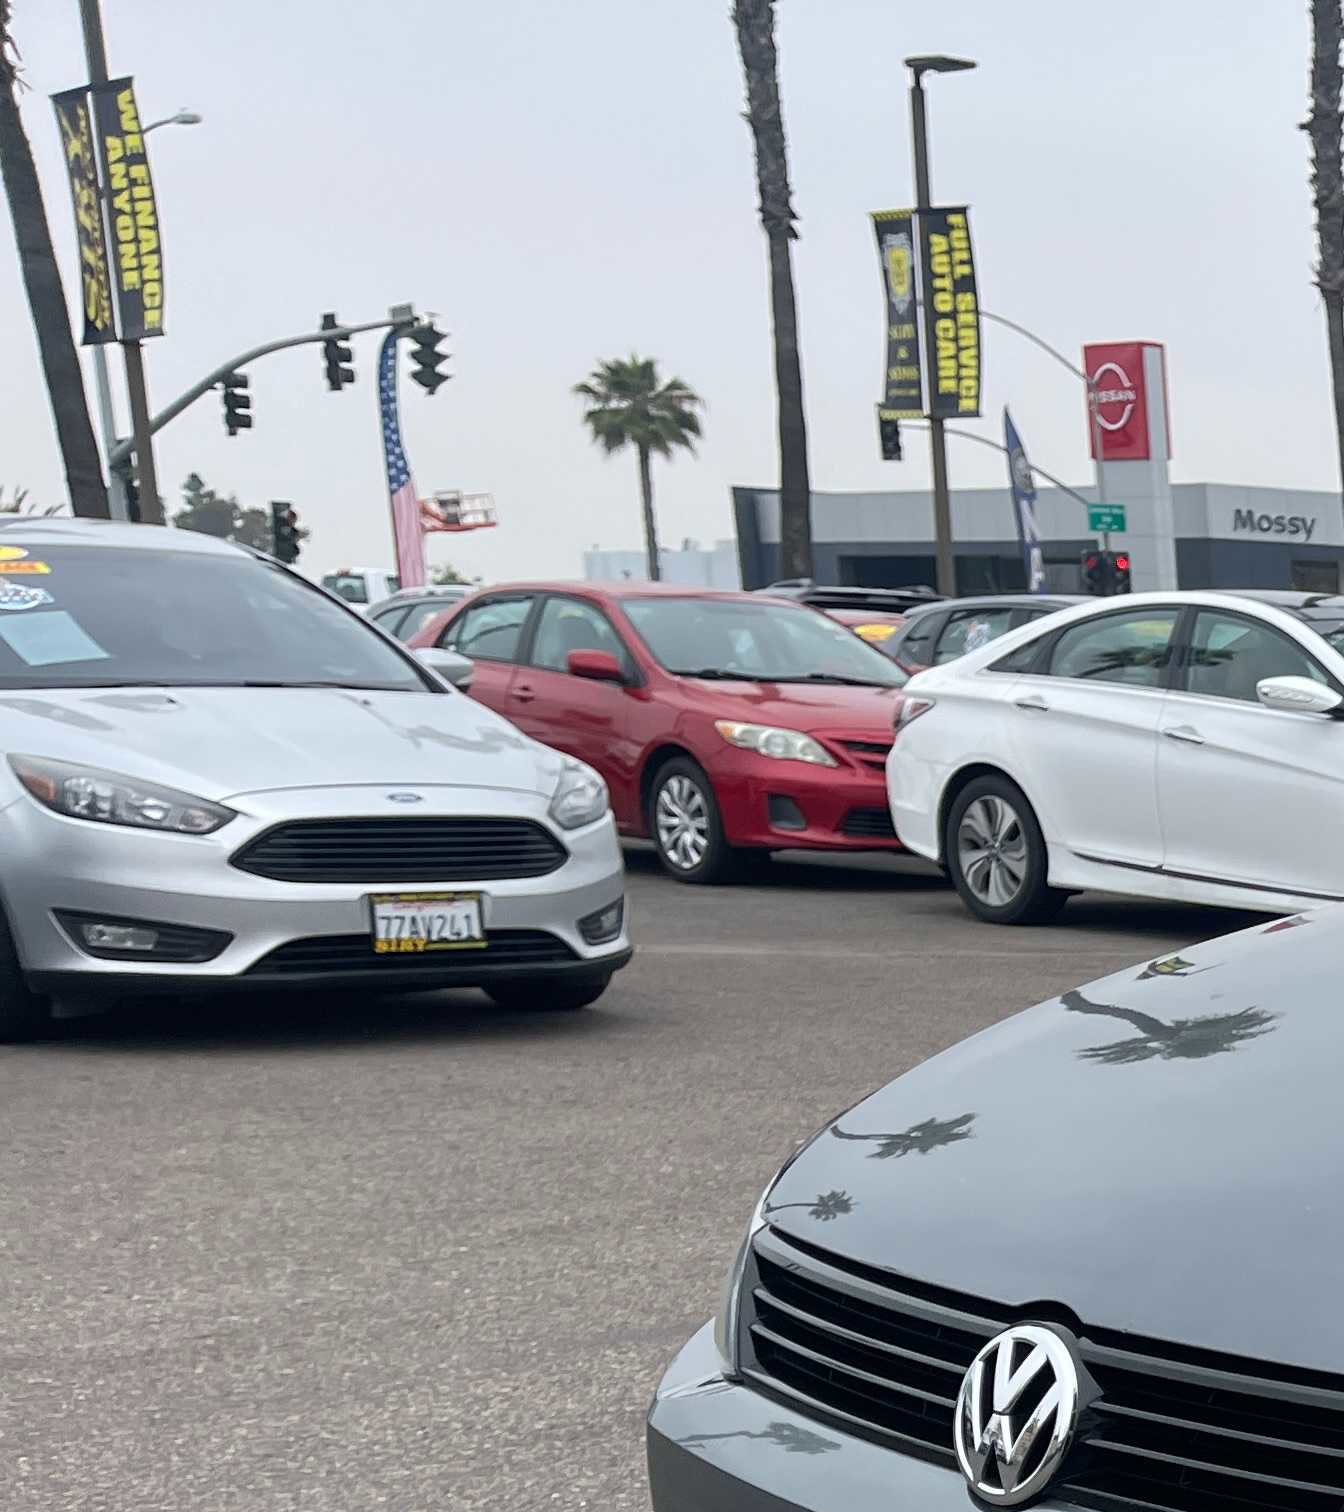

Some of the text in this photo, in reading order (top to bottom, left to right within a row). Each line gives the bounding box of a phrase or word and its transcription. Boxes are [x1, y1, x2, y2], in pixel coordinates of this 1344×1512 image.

[105, 135, 142, 291] ANYONE
[116, 88, 162, 330] WE FINANCE
[928, 232, 959, 395] AUTO CARE
[946, 213, 979, 413] FULL SERVICE
[1232, 508, 1317, 541] Mossy
